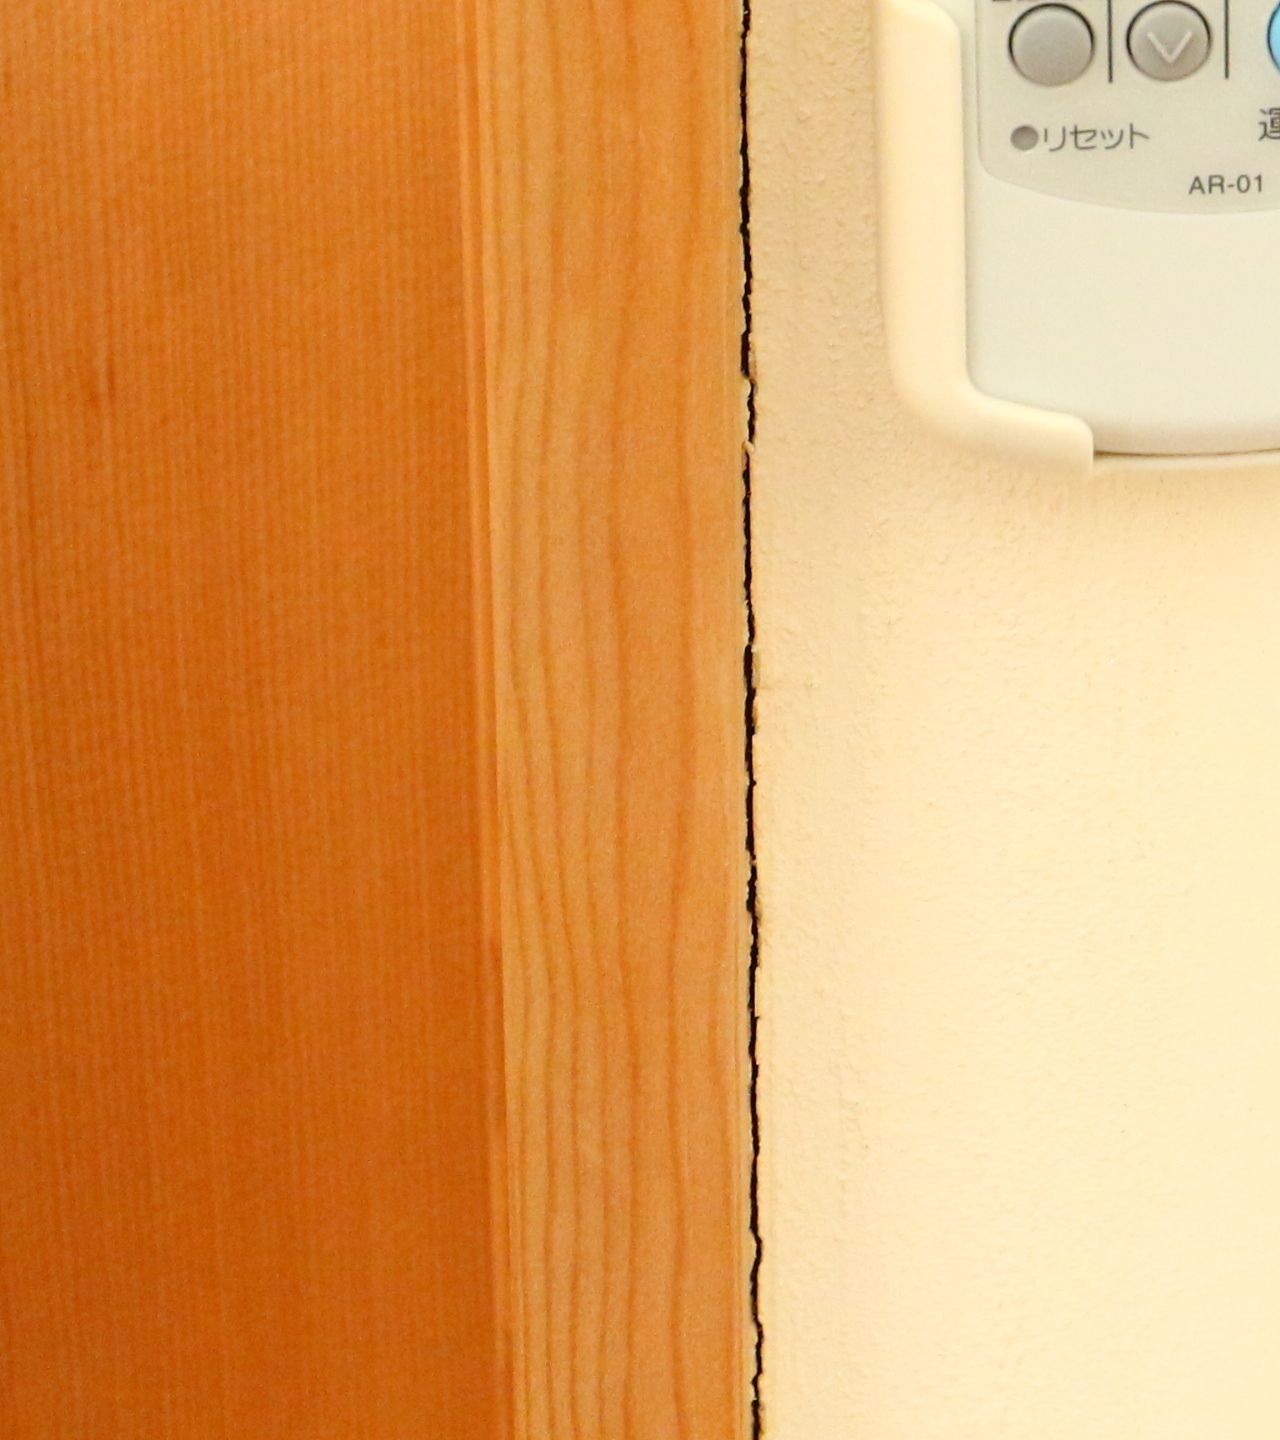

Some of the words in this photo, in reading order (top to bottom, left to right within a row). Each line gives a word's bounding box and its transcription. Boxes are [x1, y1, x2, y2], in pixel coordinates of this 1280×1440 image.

[1043, 123, 1149, 151] リセット
[1188, 175, 1264, 195] AR-01
